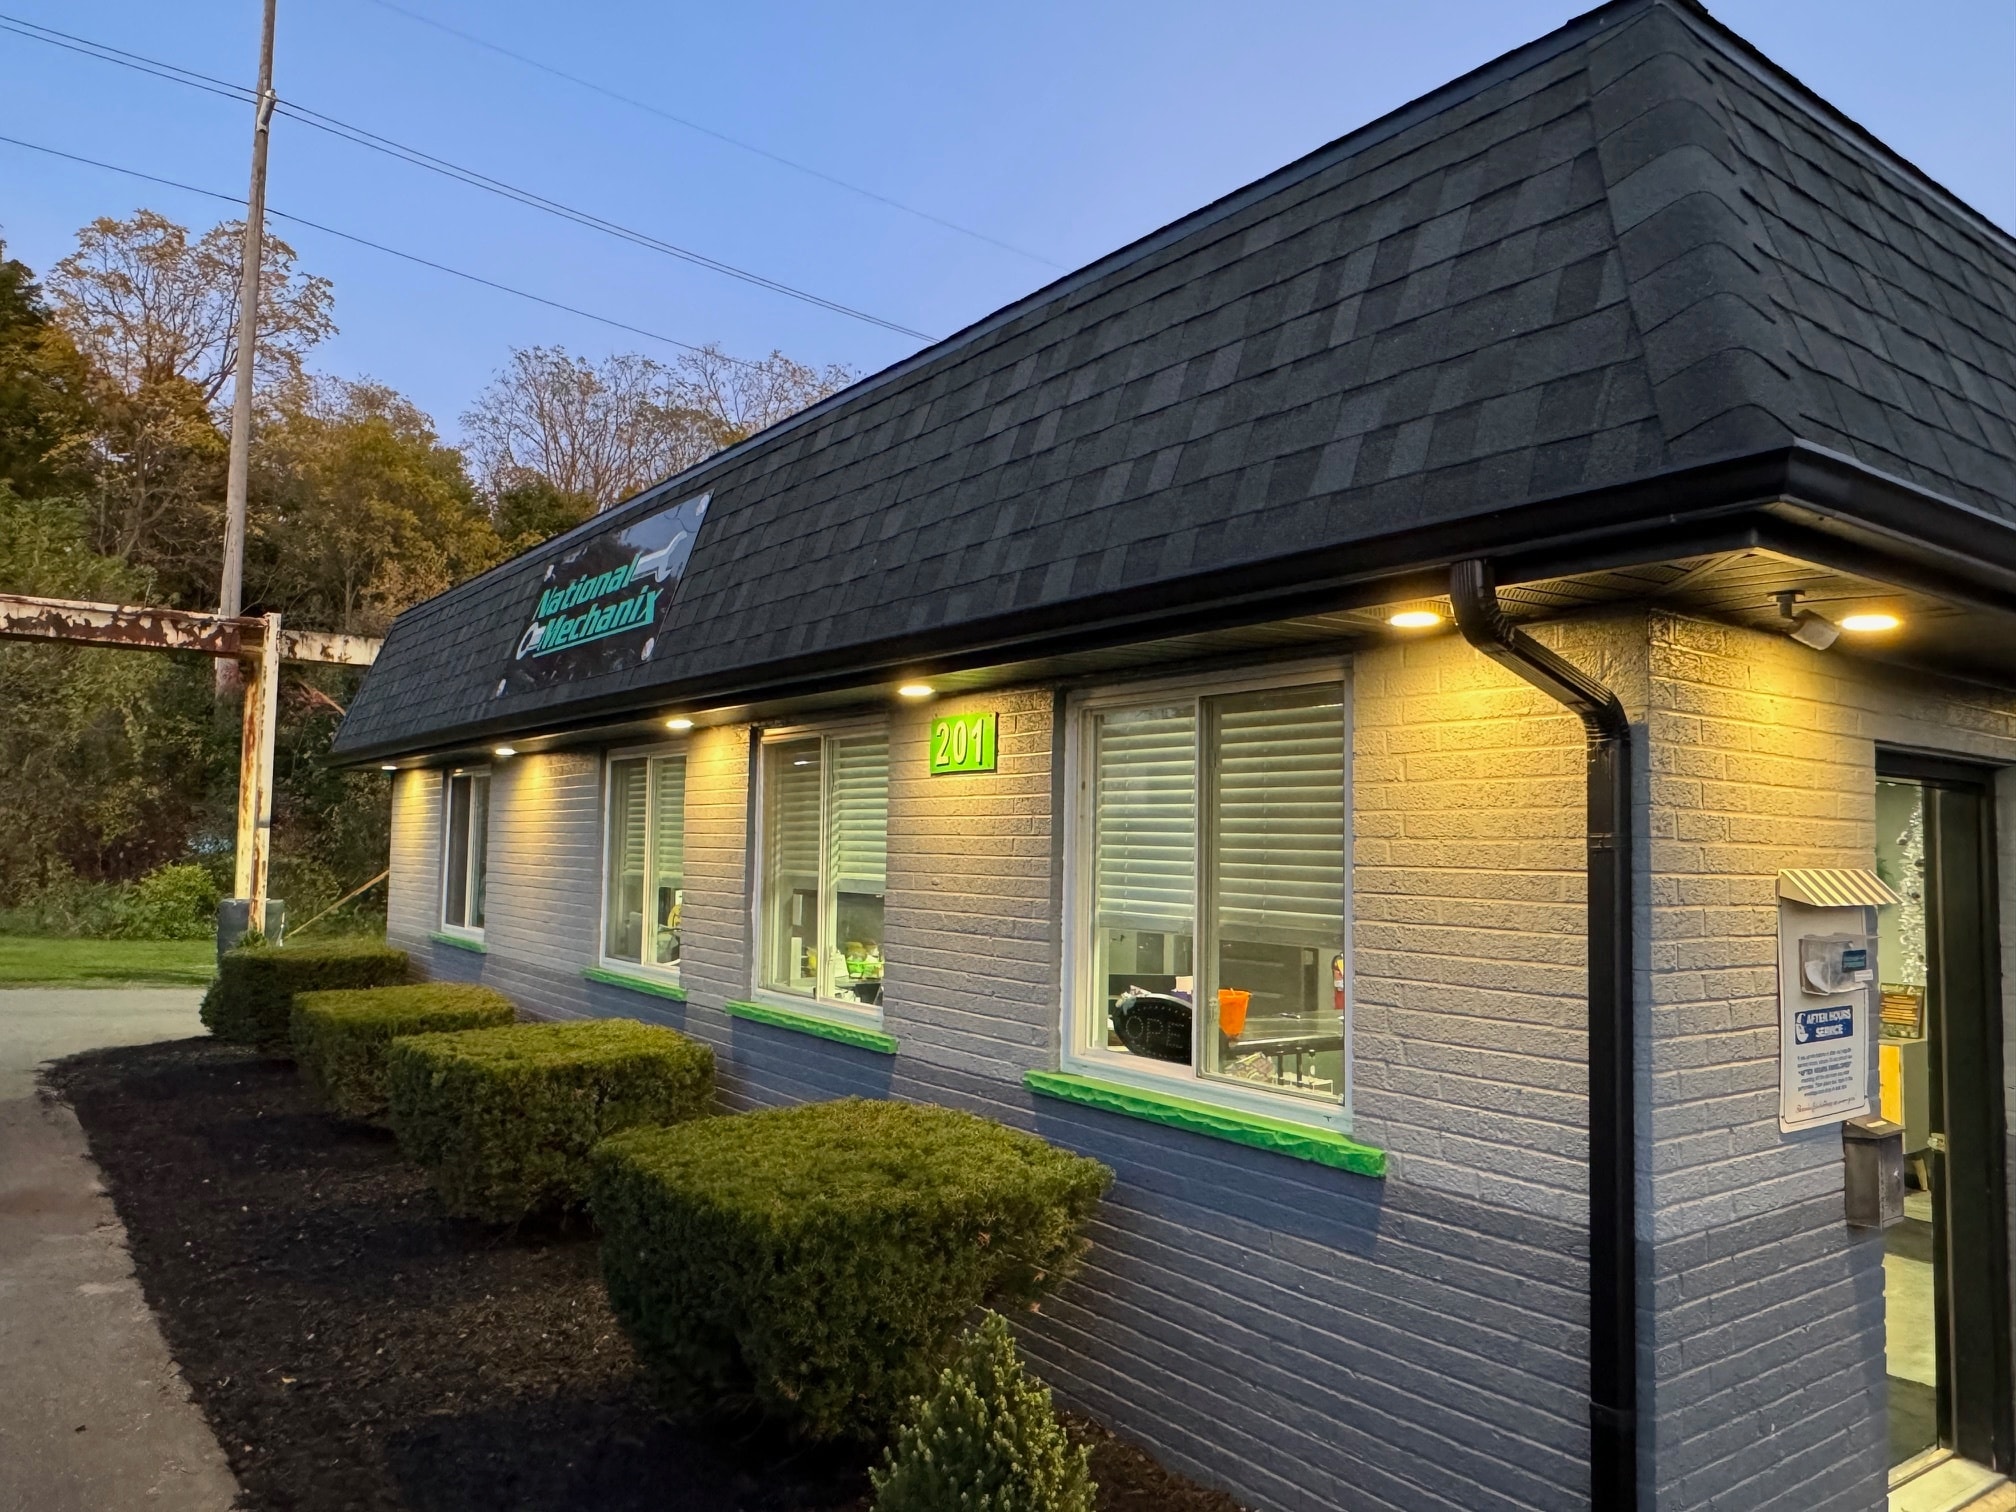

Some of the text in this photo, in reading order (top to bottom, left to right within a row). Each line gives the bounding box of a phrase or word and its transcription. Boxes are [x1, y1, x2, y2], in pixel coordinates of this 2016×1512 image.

[532, 553, 642, 621] National
[537, 585, 663, 652] Mechanix
[935, 719, 984, 767] 201
[1126, 1015, 1187, 1049] OPE
[1807, 1012, 1829, 1024] AFTER
[1815, 1024, 1844, 1038] SERVICE
